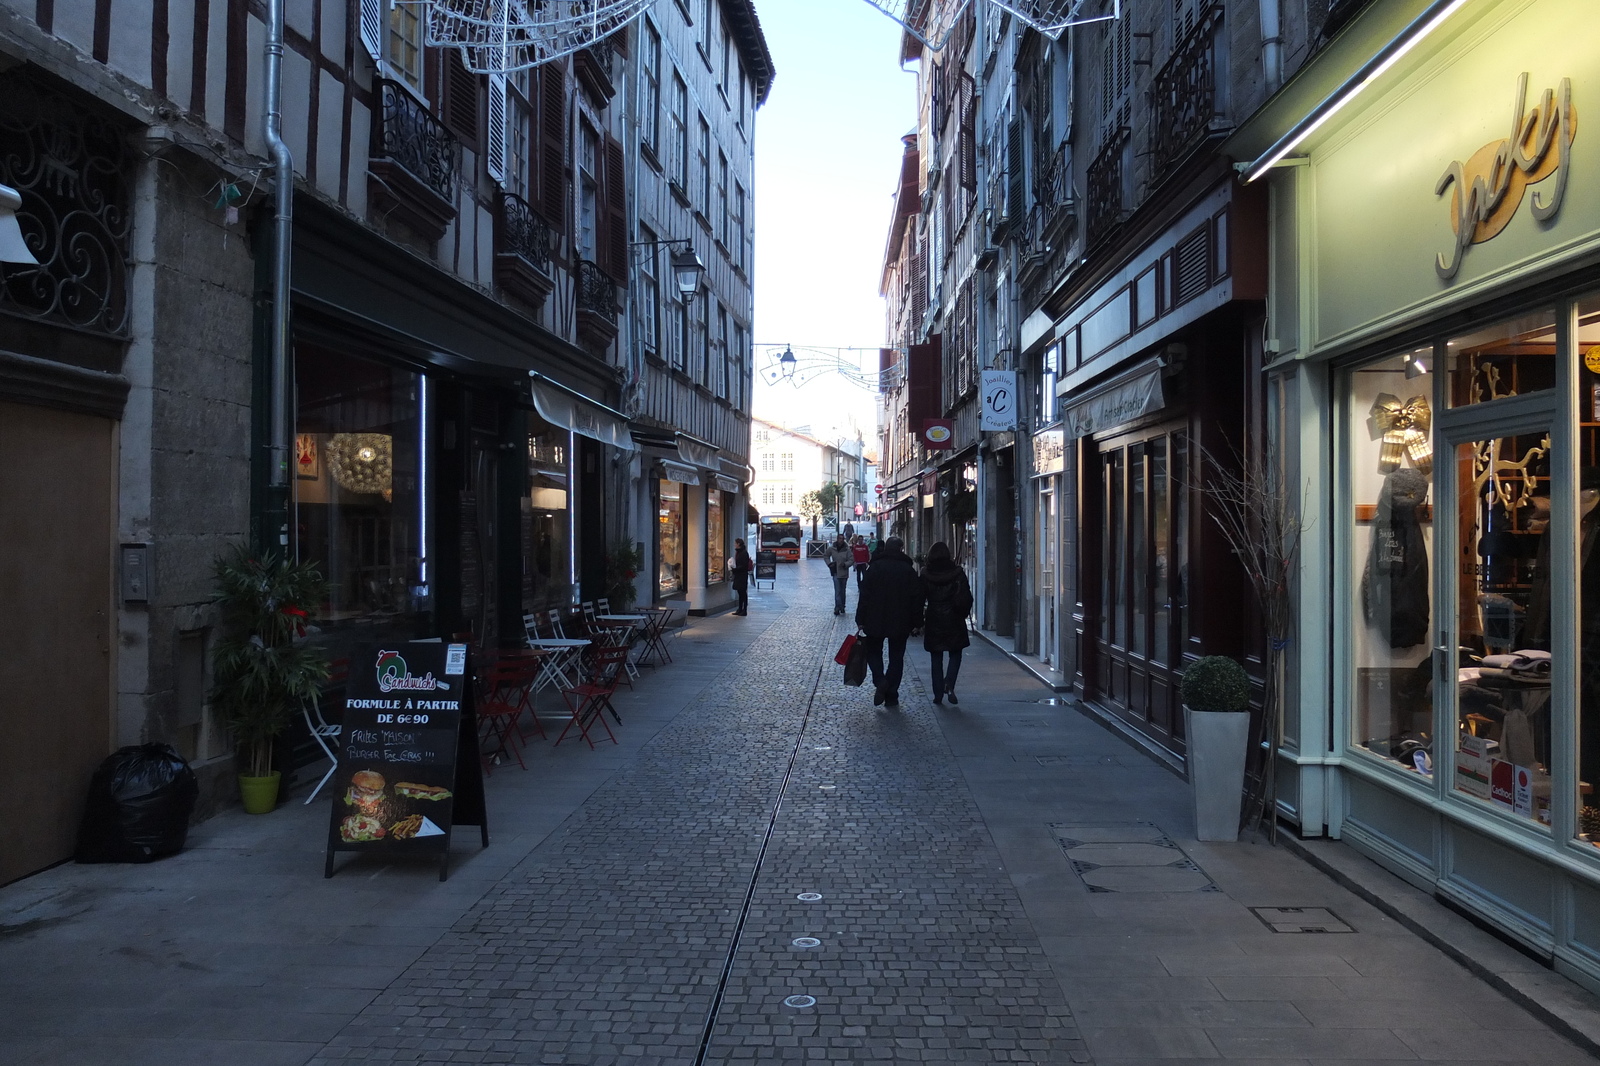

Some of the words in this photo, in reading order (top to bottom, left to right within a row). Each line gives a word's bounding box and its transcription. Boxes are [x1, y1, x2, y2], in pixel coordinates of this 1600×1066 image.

[984, 374, 1013, 386] Joaillier
[985, 415, 1014, 427] Créateur
[380, 670, 437, 693] Sandwichs
[346, 698, 402, 710] FORMULE
[404, 697, 414, 710] À
[416, 699, 460, 711] PARTIR
[377, 713, 394, 724] DE
[397, 713, 430, 725] 6€90
[1491, 784, 1512, 800] Cadhoc
